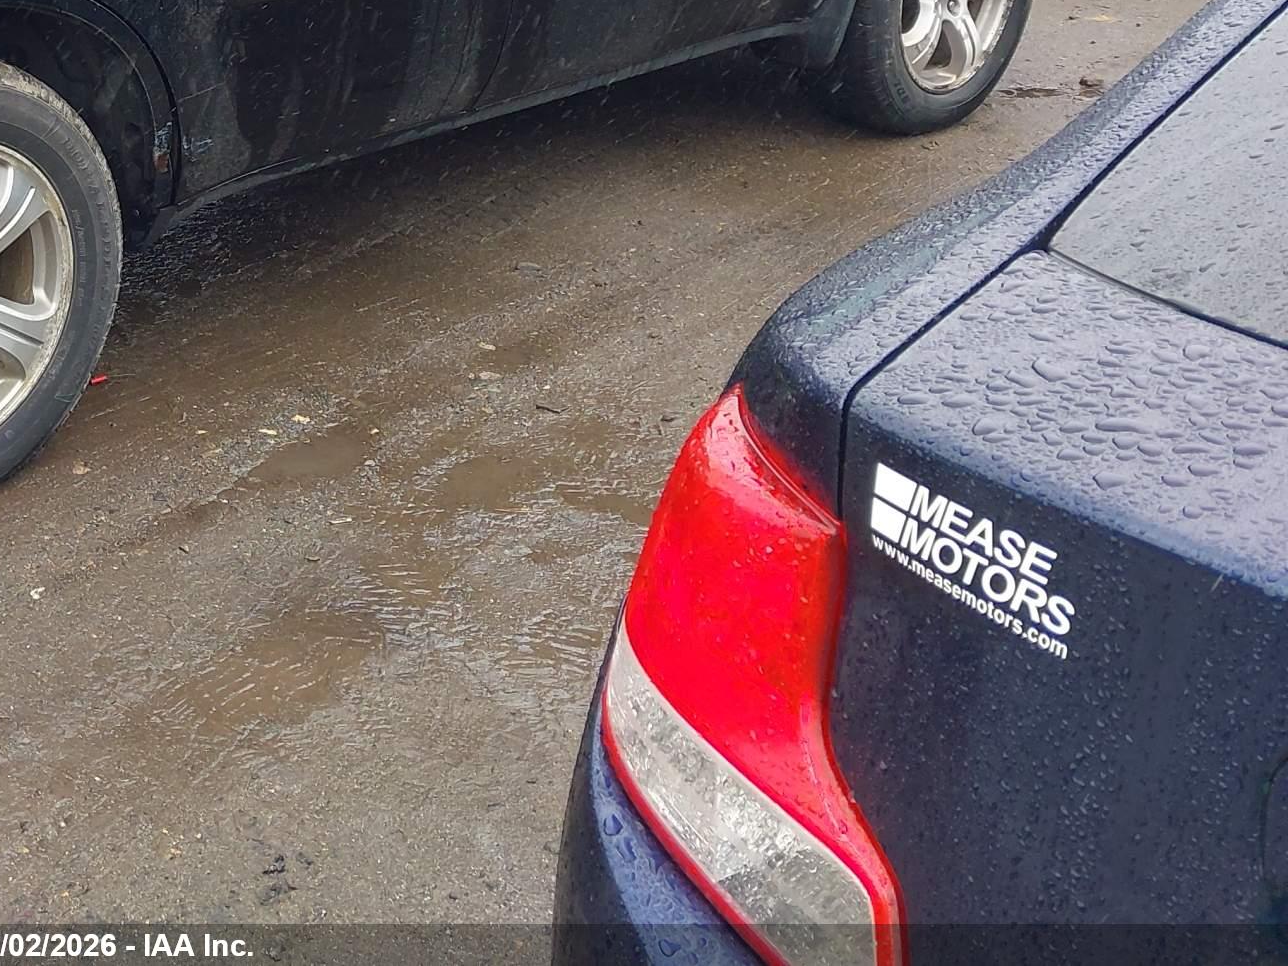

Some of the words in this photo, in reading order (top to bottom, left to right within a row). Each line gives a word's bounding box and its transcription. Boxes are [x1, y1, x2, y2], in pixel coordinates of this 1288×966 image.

[900, 517, 1076, 636] MOTORS
[910, 484, 1058, 586] MEASE
[871, 534, 1069, 660] www.measemotors.com
